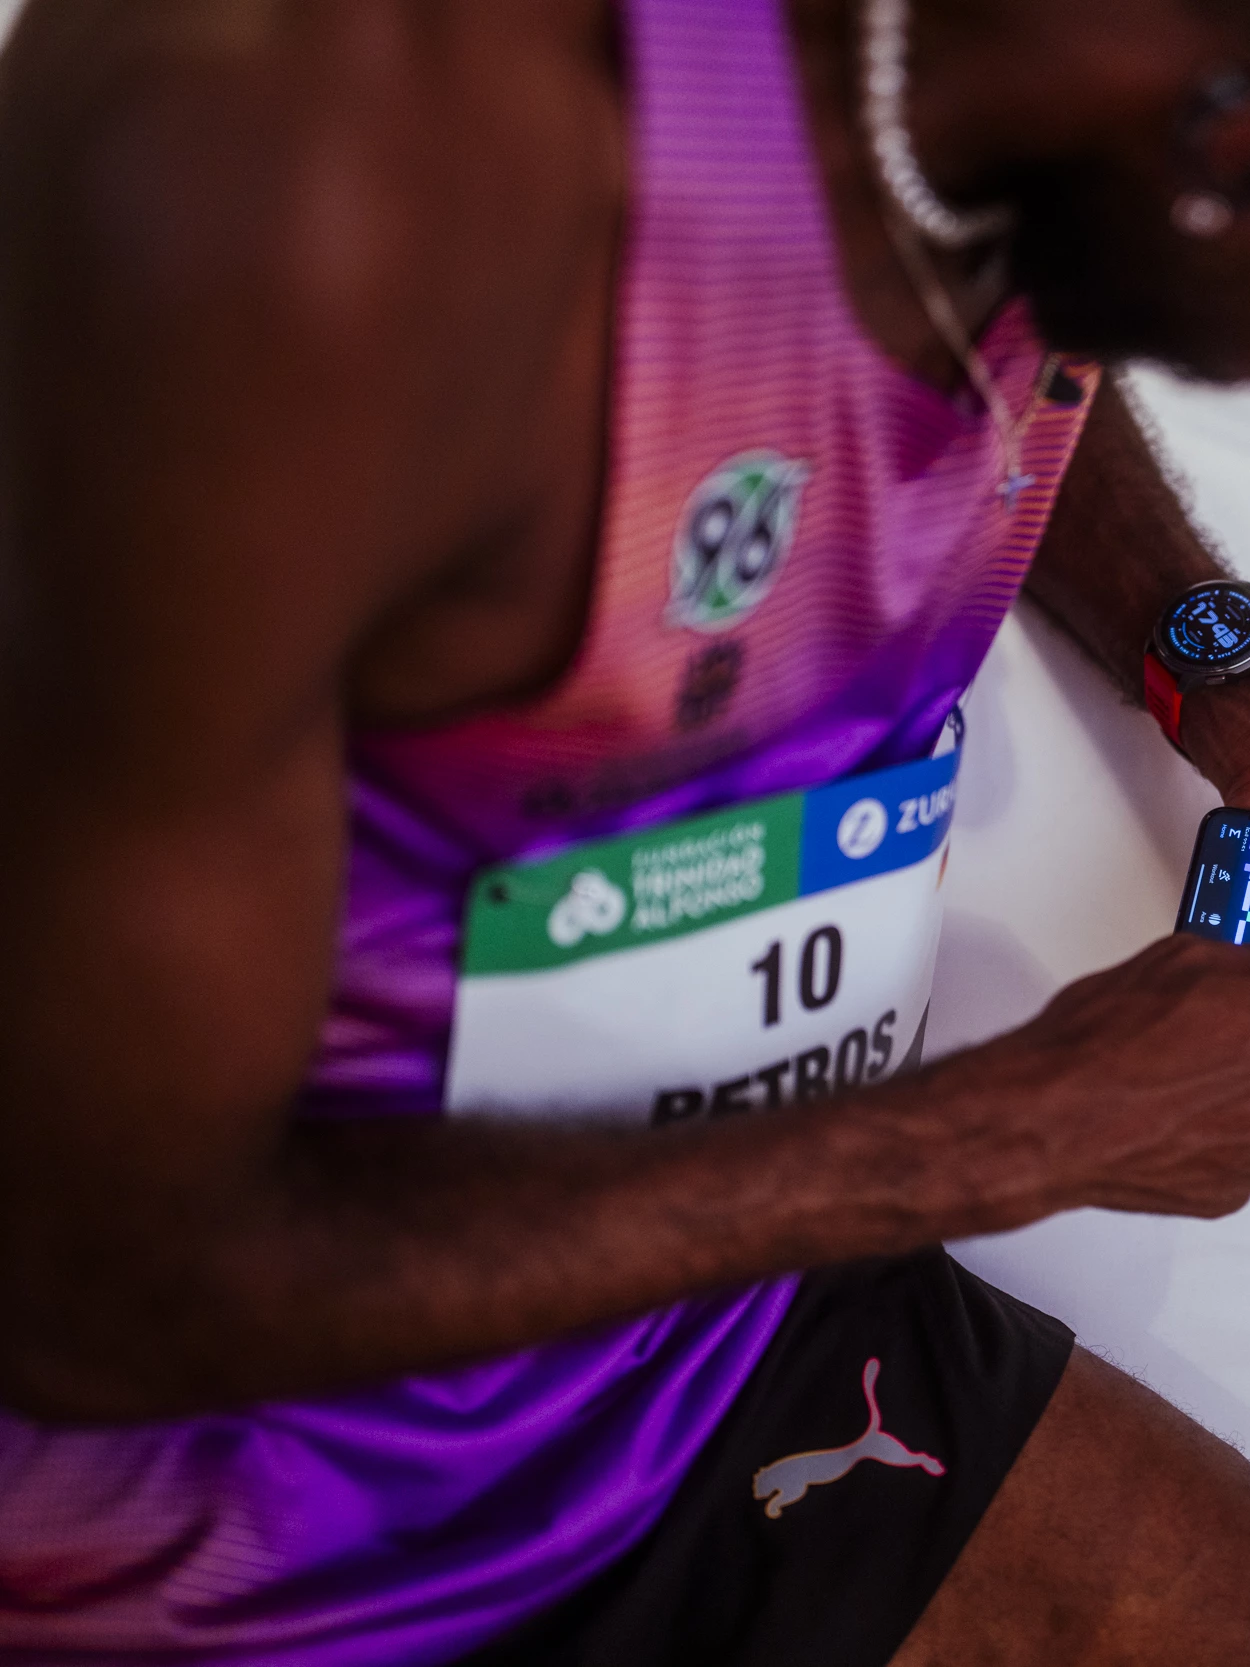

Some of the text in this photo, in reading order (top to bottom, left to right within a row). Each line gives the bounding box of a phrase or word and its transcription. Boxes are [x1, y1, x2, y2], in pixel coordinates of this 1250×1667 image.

[1219, 824, 1227, 839] Home
[1209, 864, 1218, 884] Workout
[1199, 911, 1207, 923] Aura
[752, 924, 843, 1030] 10
